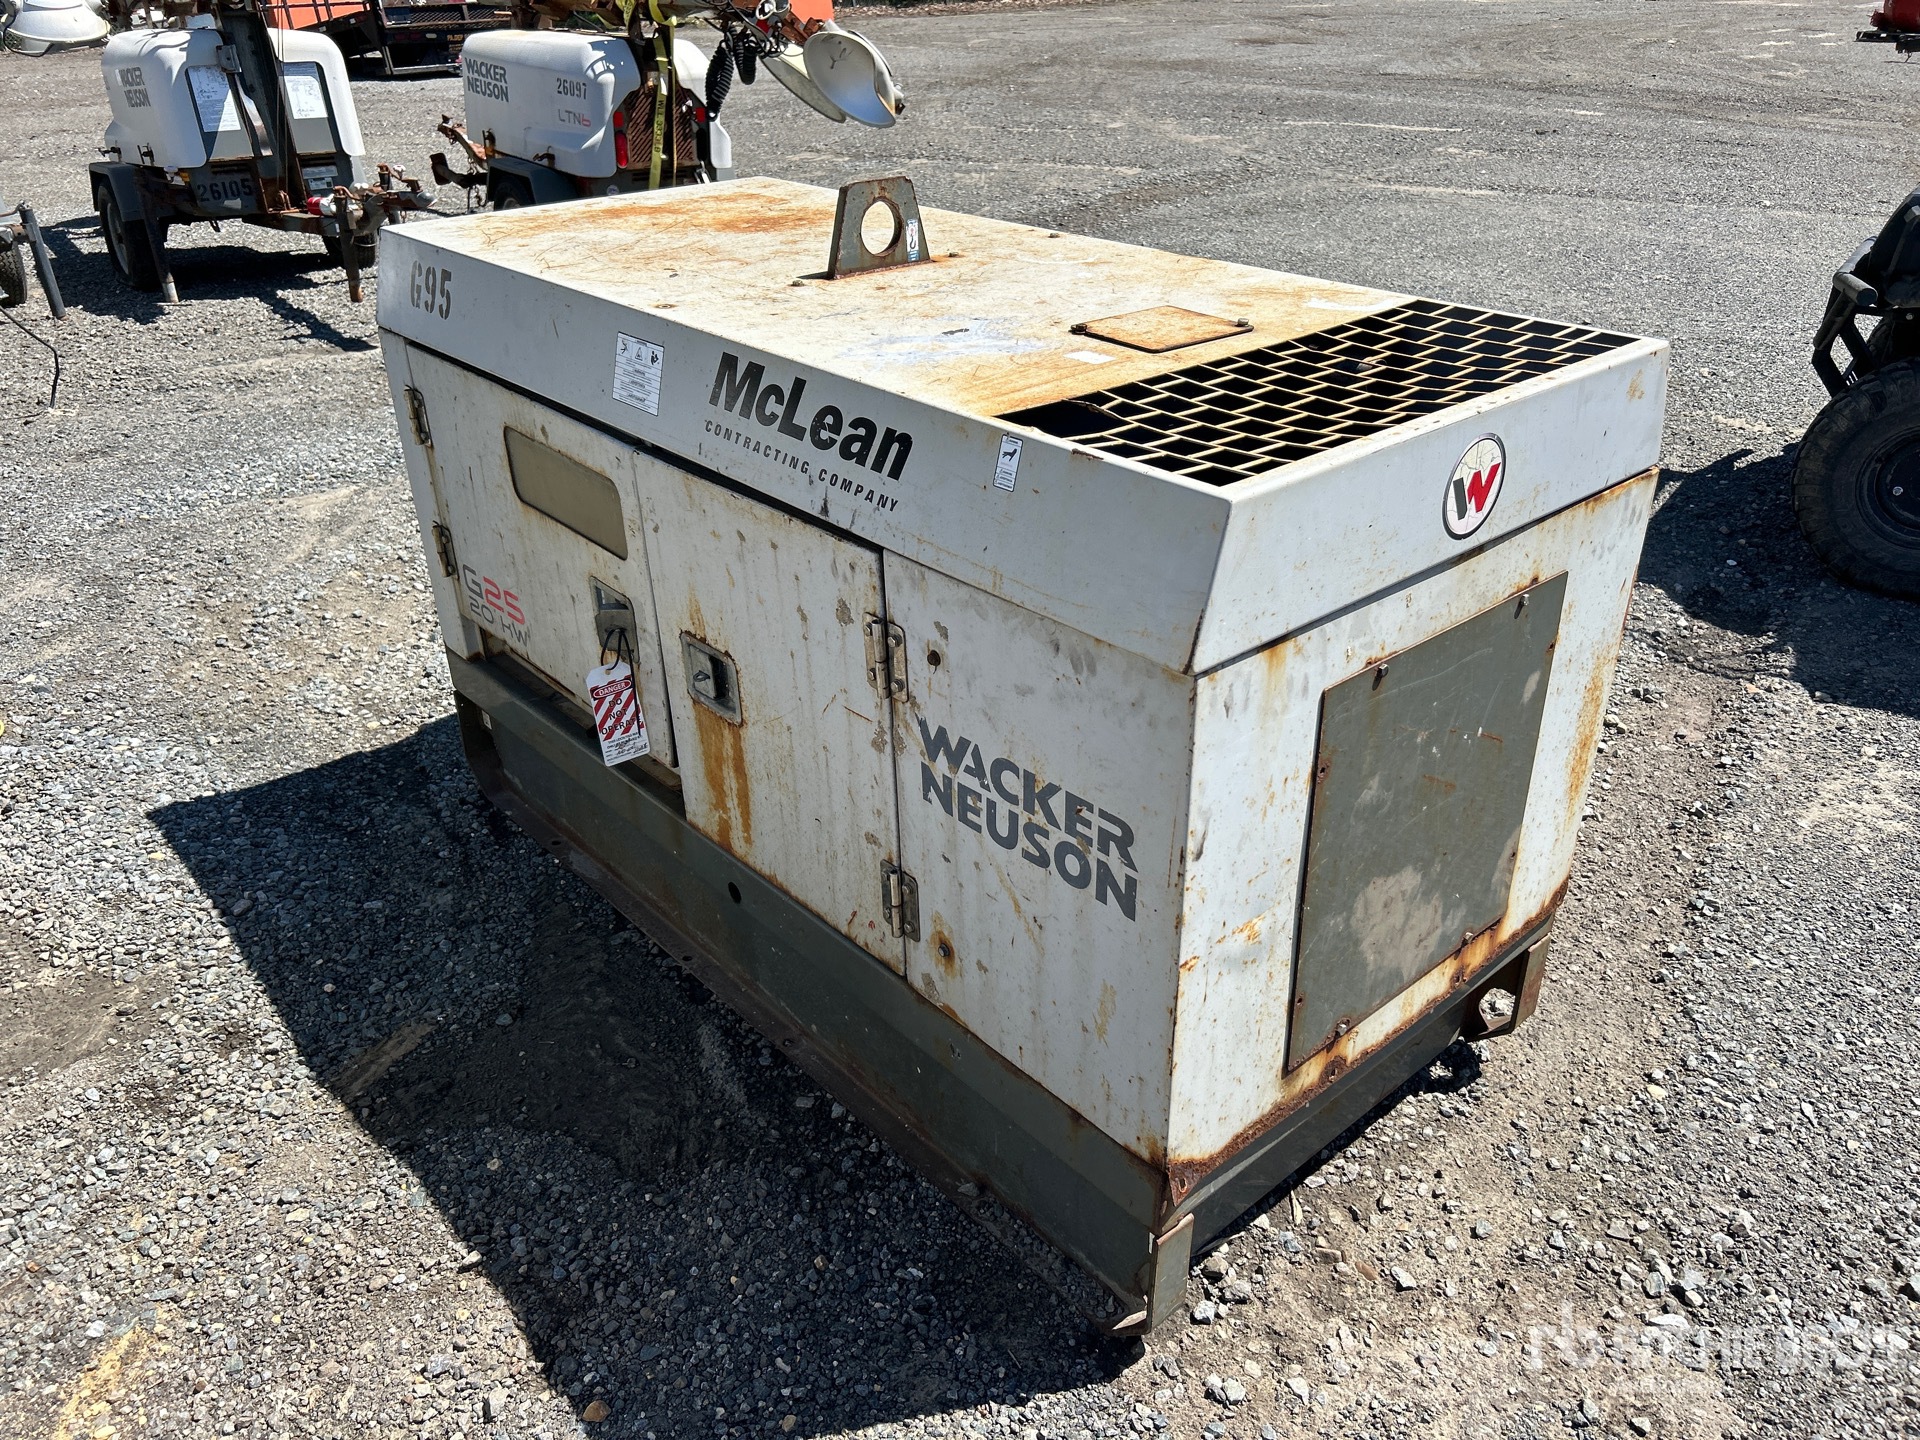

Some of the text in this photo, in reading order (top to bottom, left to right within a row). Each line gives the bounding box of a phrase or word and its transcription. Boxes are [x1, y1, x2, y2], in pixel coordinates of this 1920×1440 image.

[465, 57, 508, 85] WACKER
[466, 76, 509, 102] NEUSON
[556, 77, 587, 100] 26097
[557, 108, 592, 127] LTN6
[196, 178, 253, 202] 26105
[410, 260, 452, 321] G95
[708, 351, 914, 482] McLean
[704, 419, 900, 513] CONTRACTING COMPANY
[462, 563, 526, 626] G25
[468, 594, 495, 625] 20
[598, 682, 627, 696] DANGER
[608, 697, 623, 708] DO
[608, 707, 628, 721] NOT
[914, 711, 1140, 874] WACKER
[920, 760, 1139, 923] NEUSON
